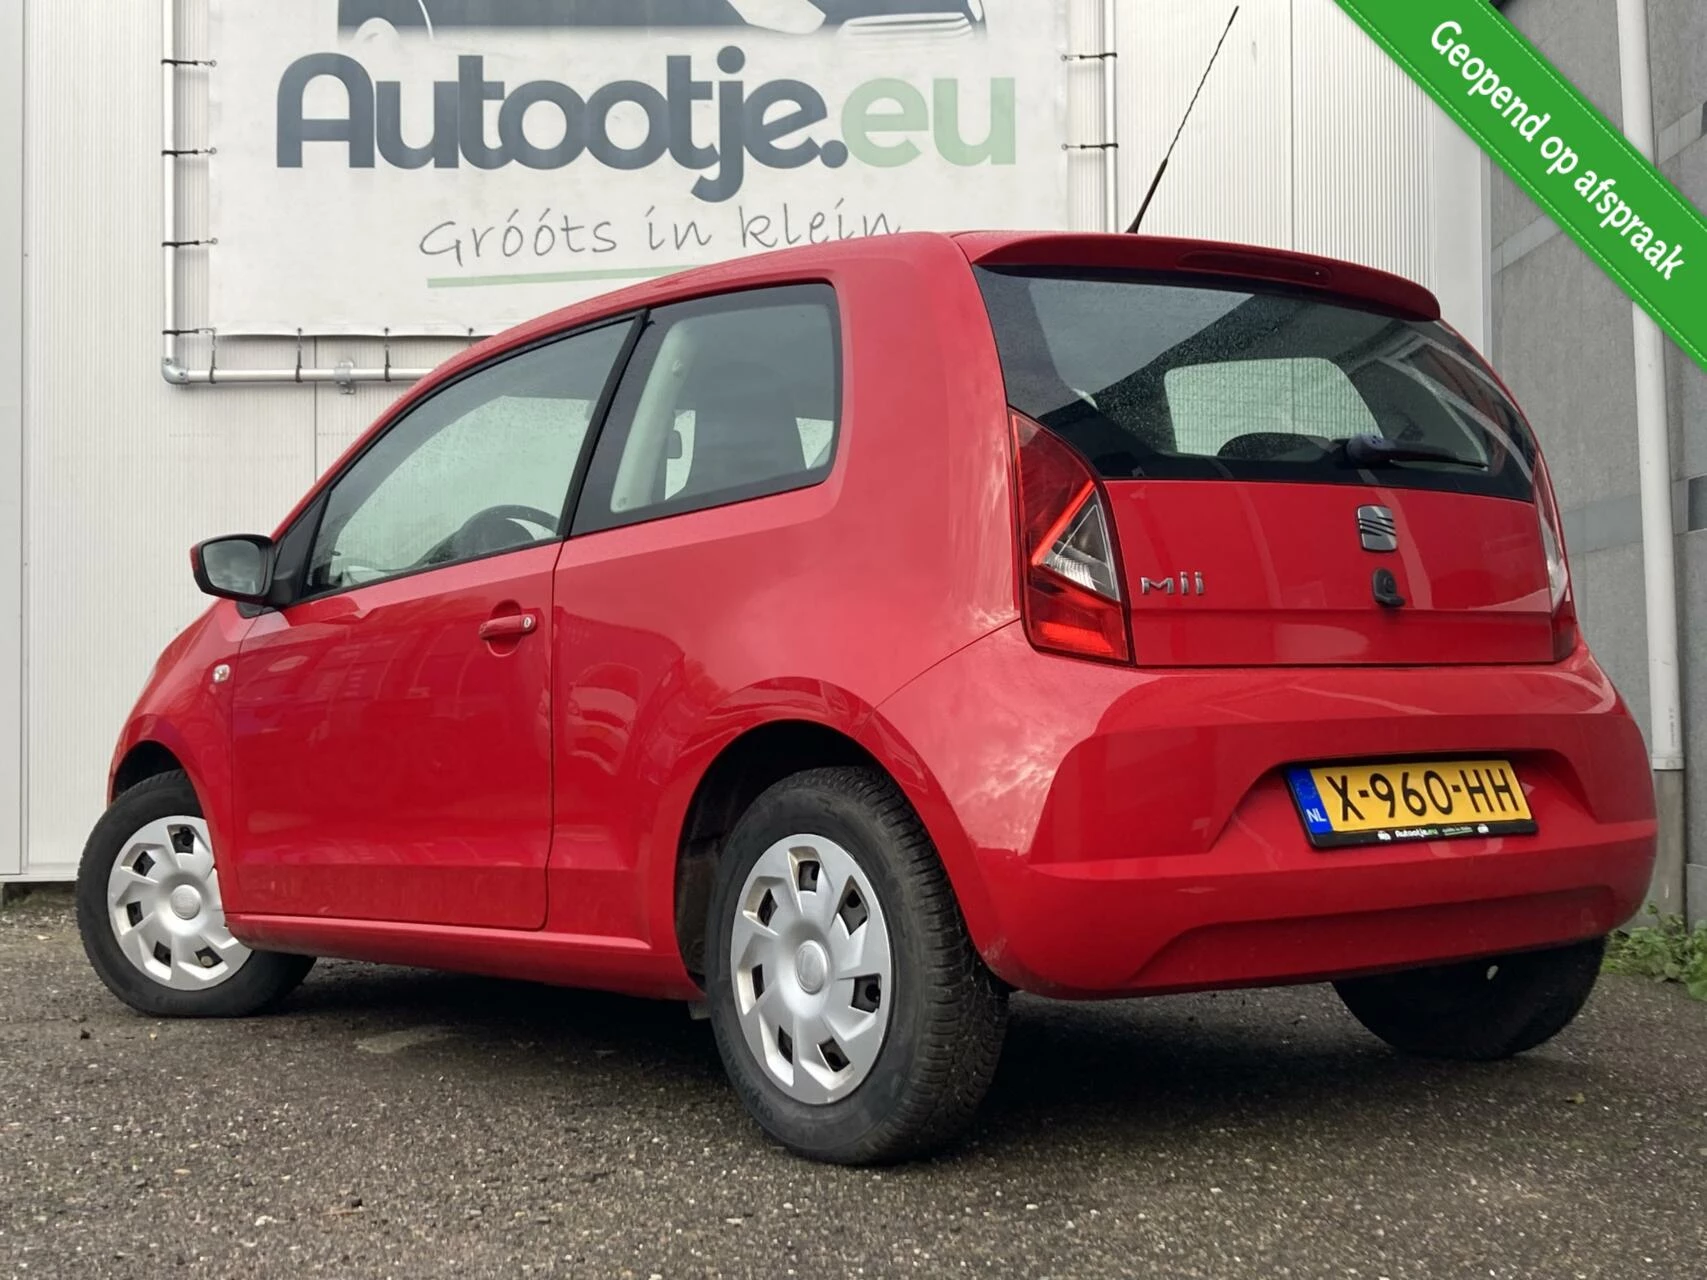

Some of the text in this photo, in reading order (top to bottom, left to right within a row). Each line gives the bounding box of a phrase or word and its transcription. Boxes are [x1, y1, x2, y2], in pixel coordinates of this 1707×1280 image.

[276, 46, 1015, 202] Autootje.eu
[419, 208, 617, 266] Gróóts
[1140, 571, 1204, 595] Mii
[1306, 808, 1326, 823] NL
[1326, 769, 1520, 822] X-960-HH
